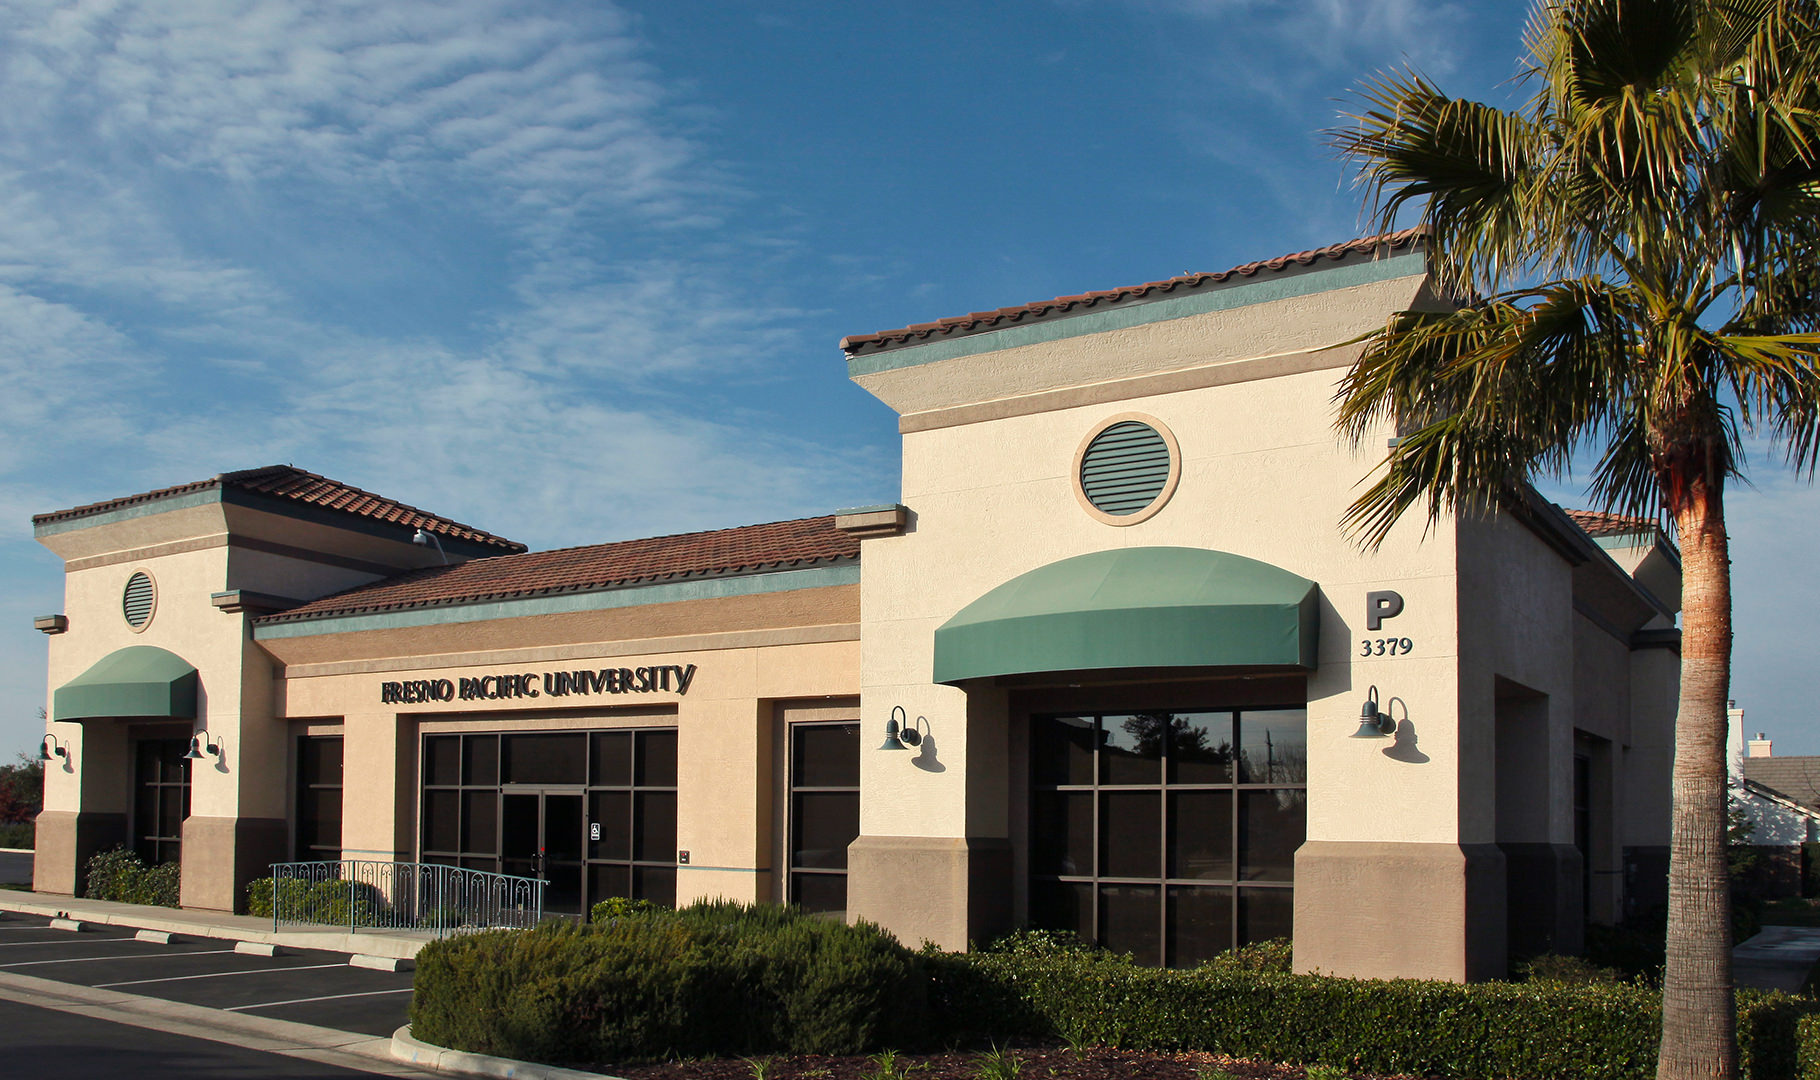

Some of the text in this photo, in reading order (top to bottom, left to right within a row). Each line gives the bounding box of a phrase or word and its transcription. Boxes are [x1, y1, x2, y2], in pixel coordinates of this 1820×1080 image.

[1366, 590, 1404, 631] P
[1360, 637, 1413, 657] 3379
[381, 663, 697, 704] FRESNO PACIFIC UNIVERSITY
